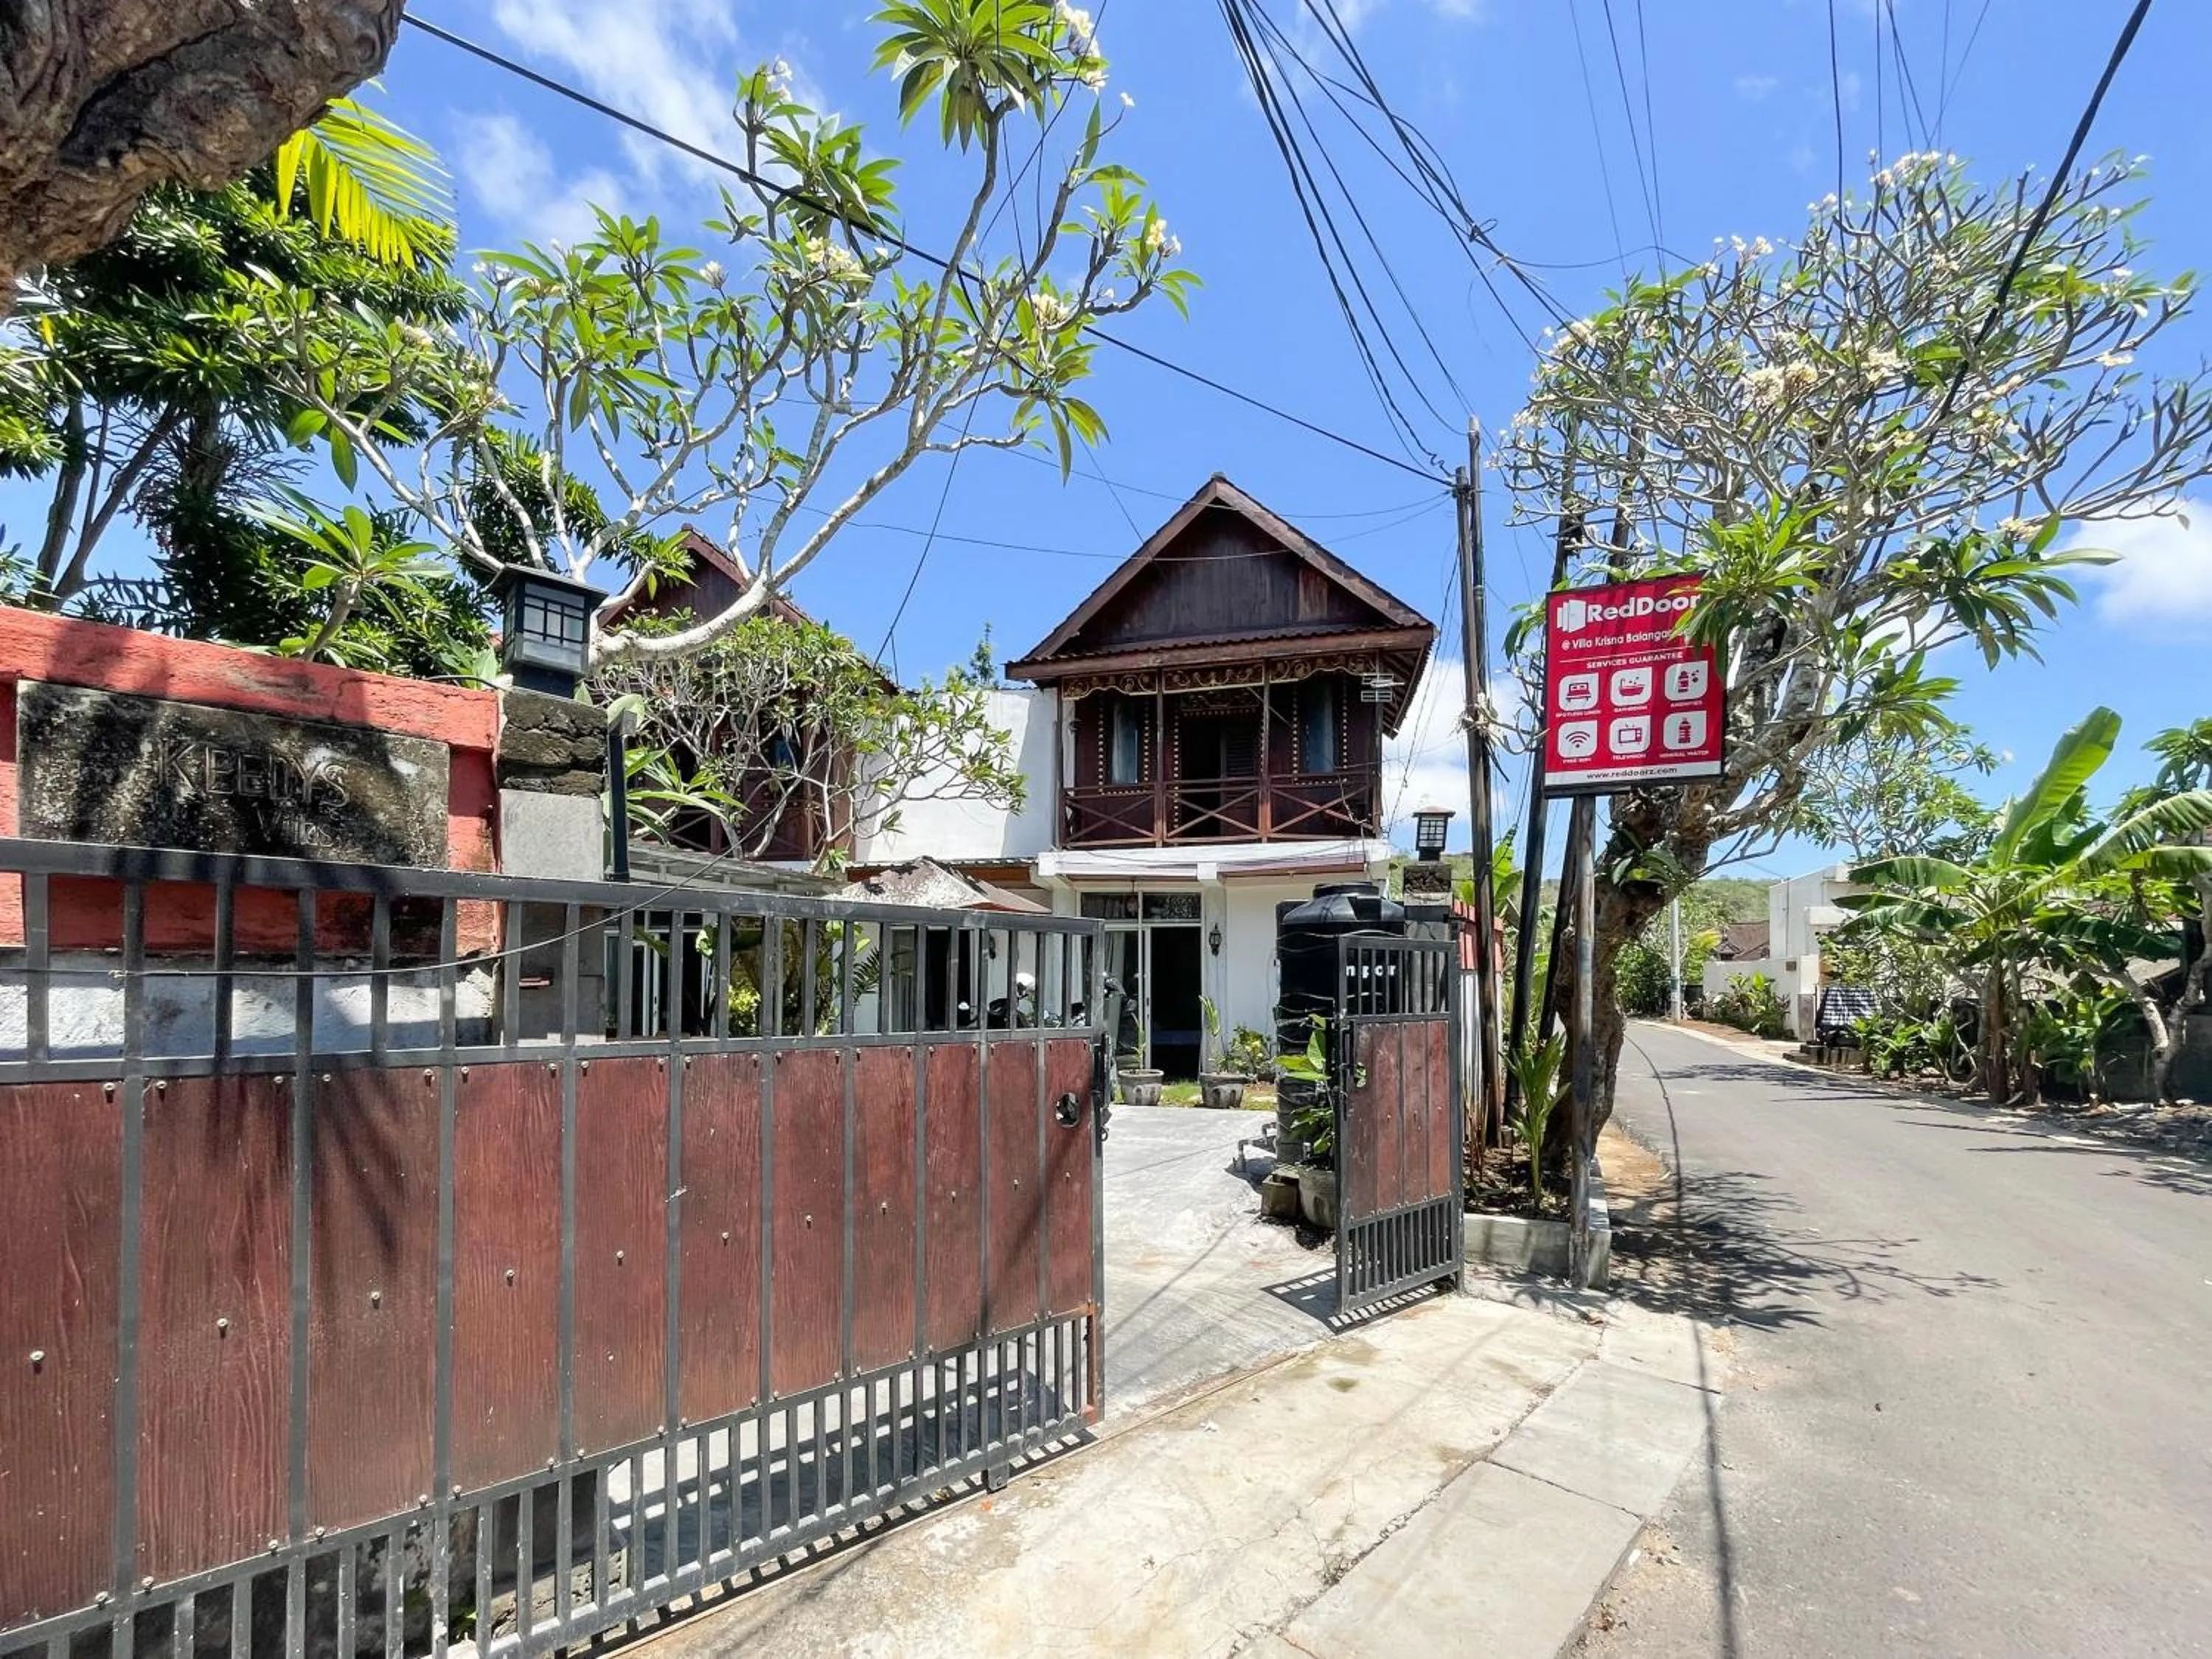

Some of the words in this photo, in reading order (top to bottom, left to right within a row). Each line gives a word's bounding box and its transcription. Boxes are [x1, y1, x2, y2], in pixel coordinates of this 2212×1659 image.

[1587, 594, 1701, 622] RedDoor
[1572, 638, 1592, 650] Villa
[1595, 636, 1624, 647] Krisna
[1627, 630, 1672, 643] Balanga
[1587, 658, 1627, 669] SERVICES
[1629, 652, 1683, 664] GUARANTEE
[1587, 766, 1677, 779] www.reddoorz.com
